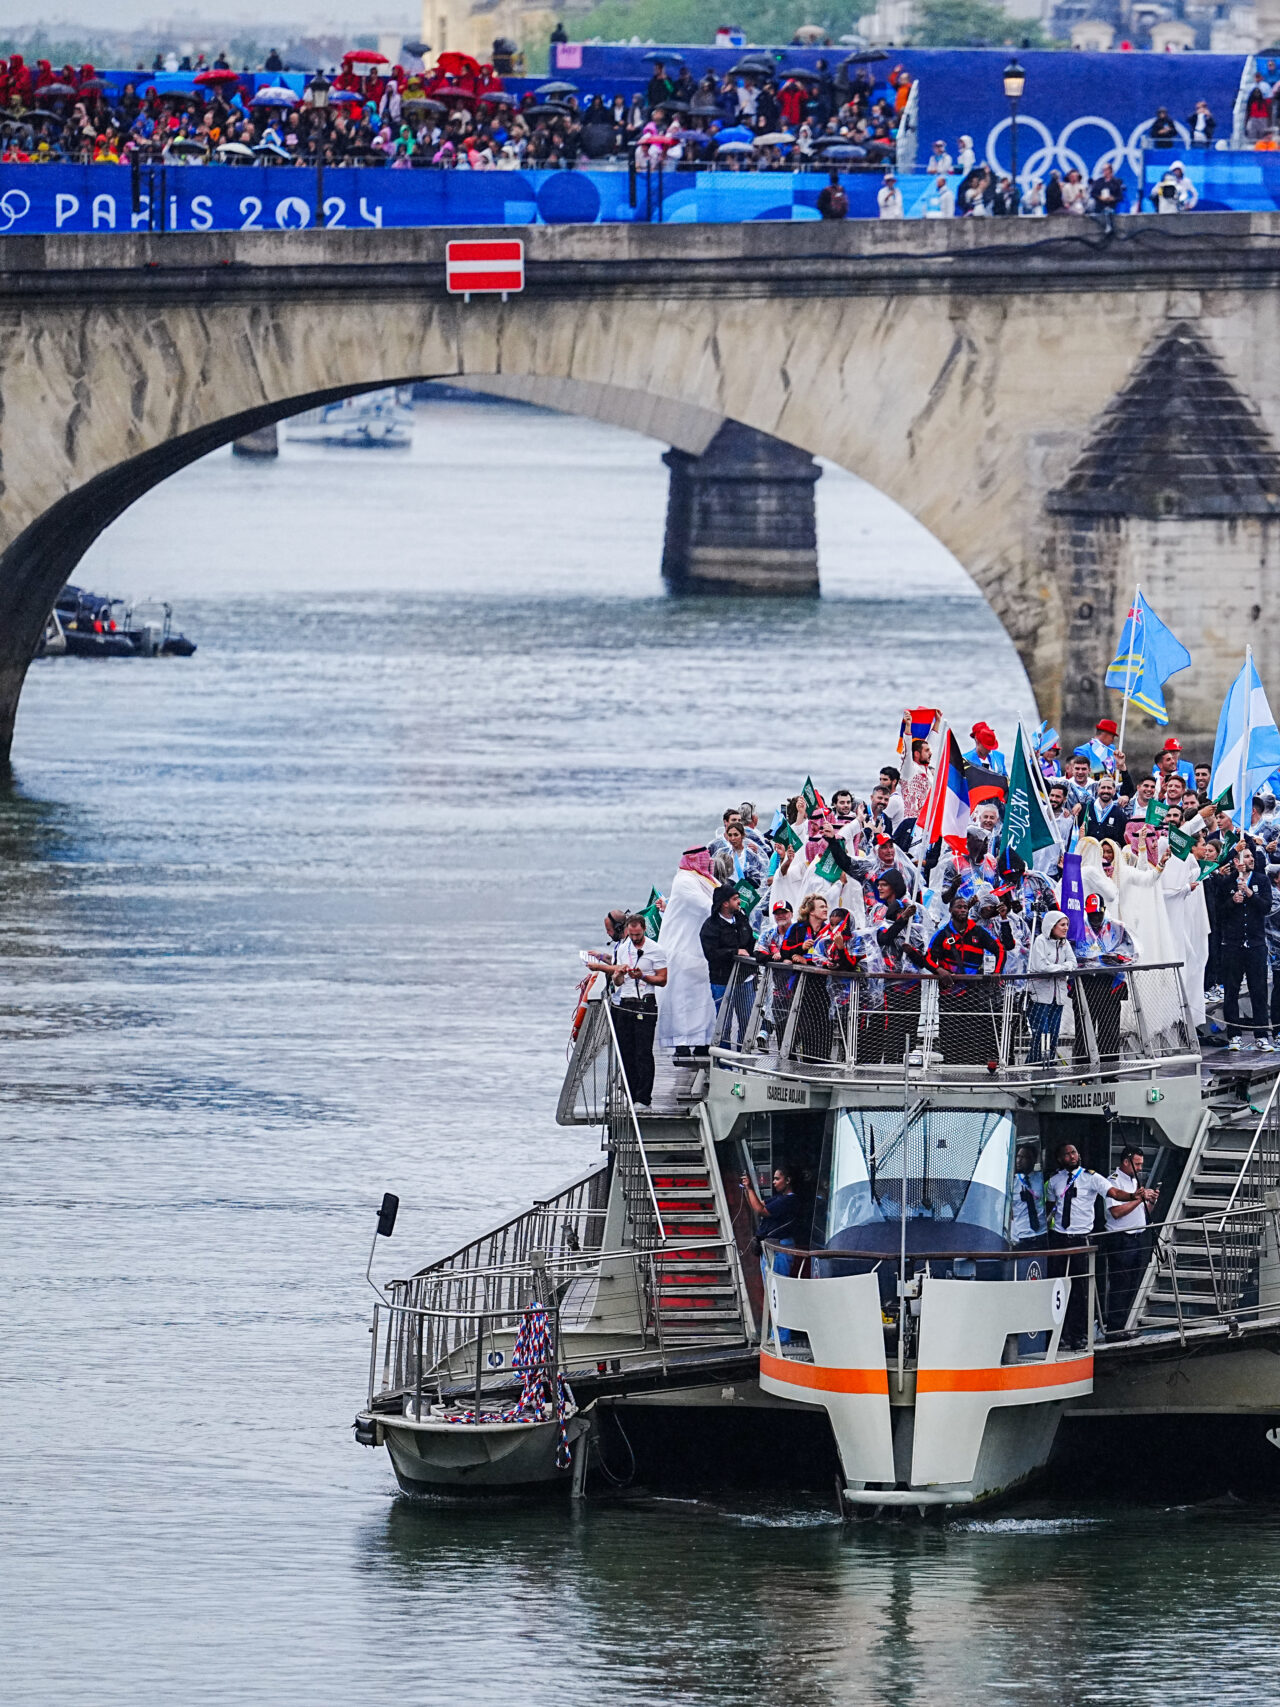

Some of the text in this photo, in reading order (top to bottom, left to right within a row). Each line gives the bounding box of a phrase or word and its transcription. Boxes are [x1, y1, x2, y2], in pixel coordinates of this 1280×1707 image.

[239, 195, 383, 231] 2024
[1061, 1091, 1116, 1110] ISABELLE ADJANI
[1055, 1289, 1062, 1311] 5
